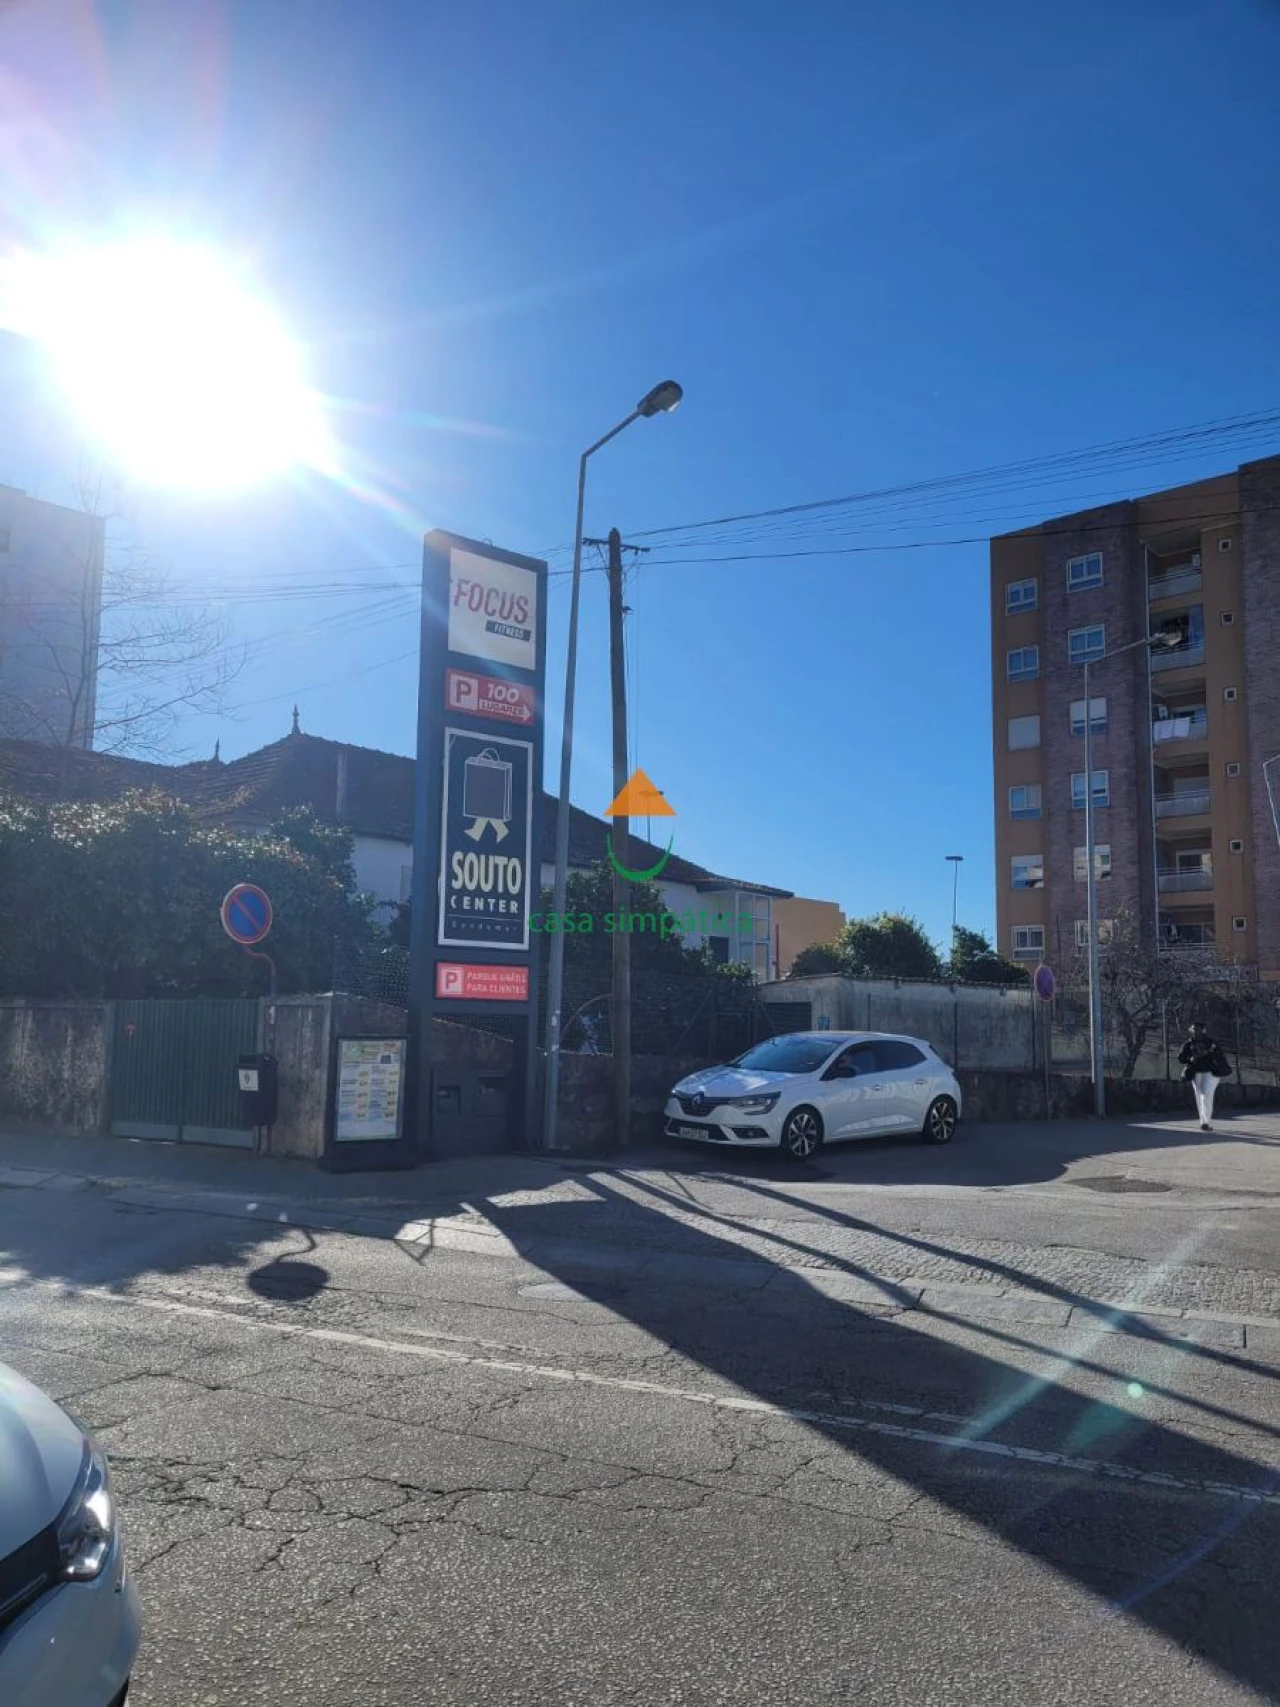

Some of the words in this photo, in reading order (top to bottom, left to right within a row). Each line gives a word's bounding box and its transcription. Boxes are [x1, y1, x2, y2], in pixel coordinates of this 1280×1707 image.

[454, 579, 528, 624] FOCUS
[456, 680, 472, 703] P
[487, 683, 520, 703] 100
[451, 851, 523, 895] SOUTO
[450, 895, 519, 914] CENTER
[445, 972, 458, 990] P
[466, 983, 487, 992] PARA
[489, 984, 526, 994] CLIENTES
